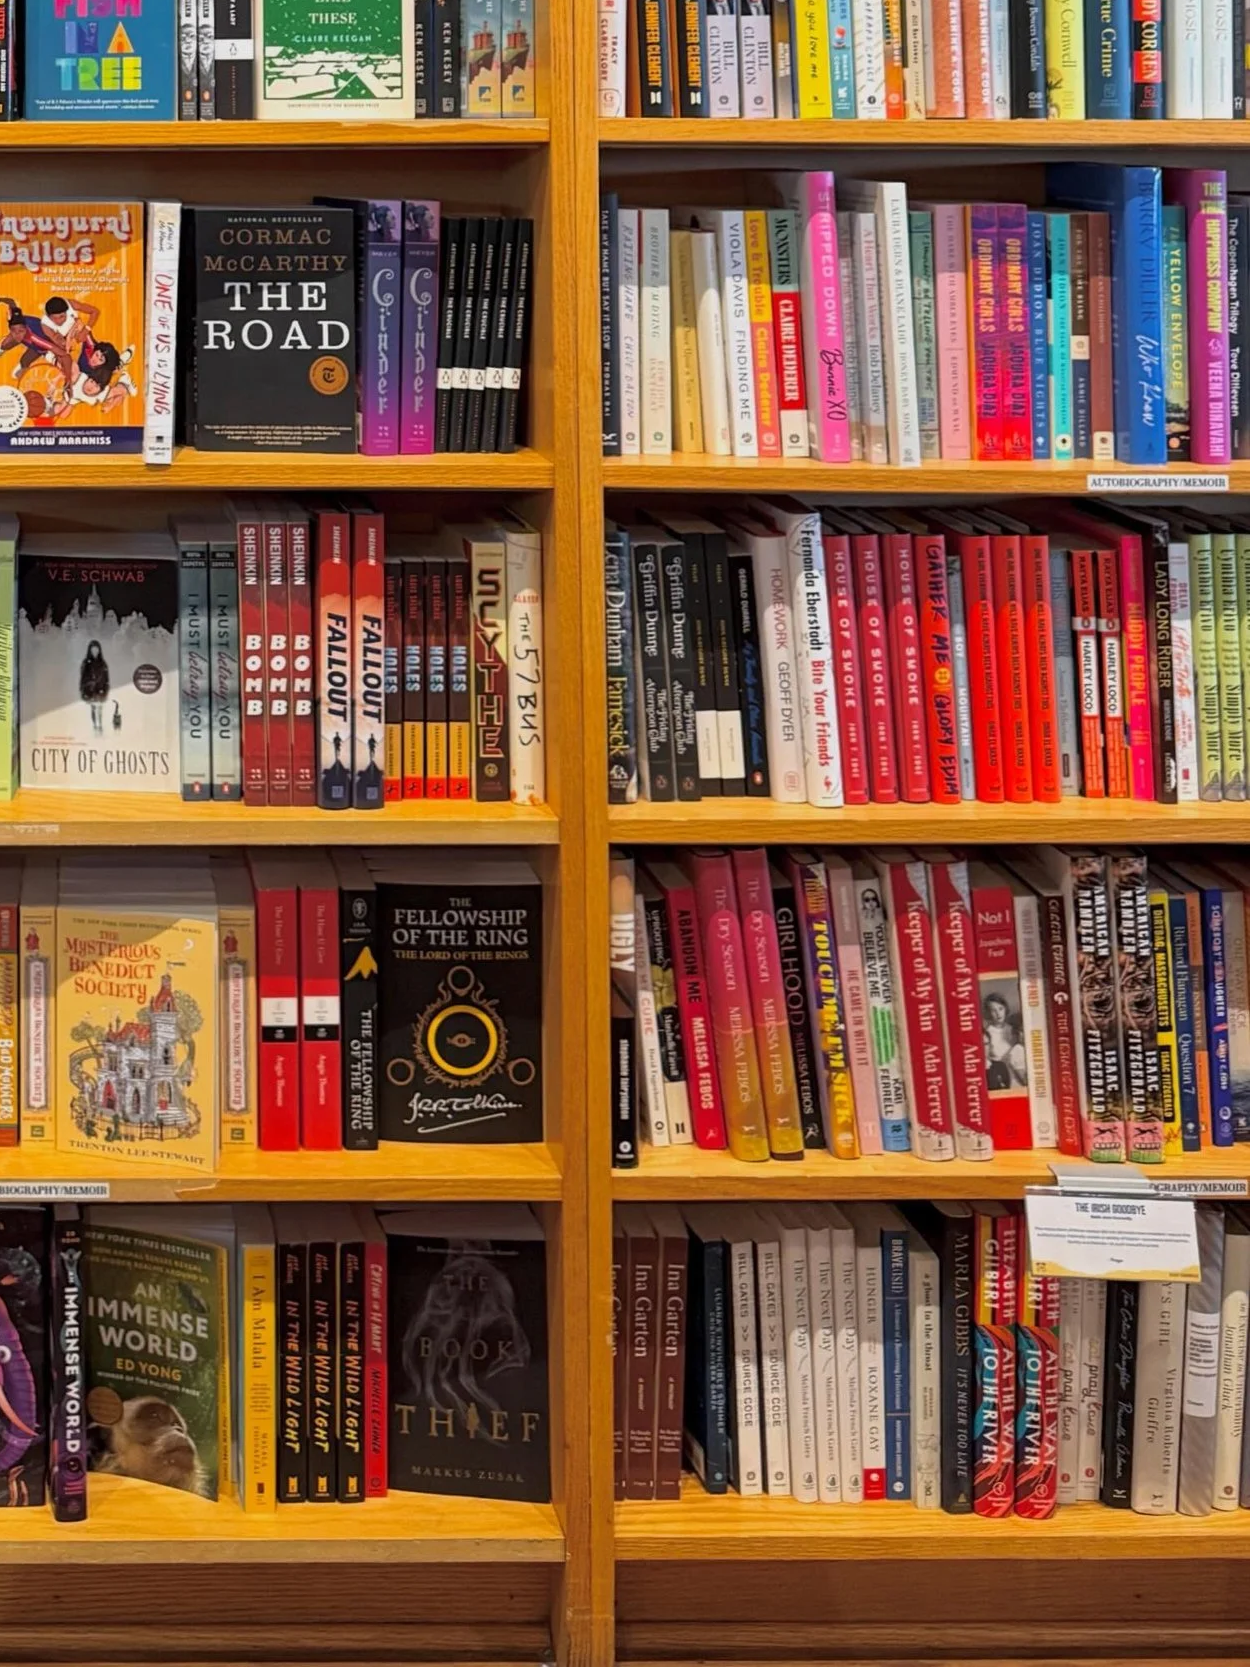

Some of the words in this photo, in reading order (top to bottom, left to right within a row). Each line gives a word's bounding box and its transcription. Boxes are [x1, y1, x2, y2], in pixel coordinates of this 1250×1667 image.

[308, 11, 358, 25] THESE
[65, 21, 99, 54] IN
[107, 21, 134, 54] A
[294, 34, 327, 44] CLAIRE
[332, 34, 372, 44] KEEGAN
[1101, 24, 1113, 79] Crime
[56, 57, 142, 91] TREE
[218, 228, 332, 246] CORMAC
[818, 190, 837, 274] STRIPPED
[203, 255, 348, 272] McCARTHY
[223, 281, 327, 311] THE
[823, 280, 838, 337] DOWN
[203, 320, 350, 351] ROAD
[10, 437, 56, 447] ANDREW
[60, 436, 112, 446] MARANISS
[1091, 478, 1226, 489] AUTOBIOGRAPHY/MEMOIR
[48, 570, 72, 582] V.E.
[76, 570, 145, 584] SCHWAB
[245, 634, 263, 716] BOMB
[327, 612, 348, 721] FALLOUT
[476, 567, 504, 759] SCYTHE
[31, 749, 70, 773] CITY
[78, 750, 96, 773] OF
[103, 750, 170, 775] GHOSTS
[450, 897, 472, 907] THE
[395, 908, 526, 926] FELLOWSHIP
[393, 928, 422, 945] OF
[427, 928, 467, 946] THE
[472, 928, 528, 947] RING
[394, 950, 413, 959] THE
[417, 950, 449, 960] LORD
[452, 950, 465, 960] OF
[466, 950, 489, 960] THE
[492, 950, 529, 960] RINGS
[776, 908, 802, 1025] GIRLHOOD
[69, 959, 156, 980] BENEDICT
[69, 1139, 123, 1155] TRENTON
[127, 1146, 149, 1157] LEE
[152, 1149, 206, 1166] STEWART
[134, 1283, 161, 1300] AN
[88, 1298, 209, 1338] IMMENSE
[98, 1324, 198, 1363] WORLD
[420, 1337, 513, 1360] BOOK
[116, 1358, 135, 1373] ED
[138, 1361, 182, 1382] YONG
